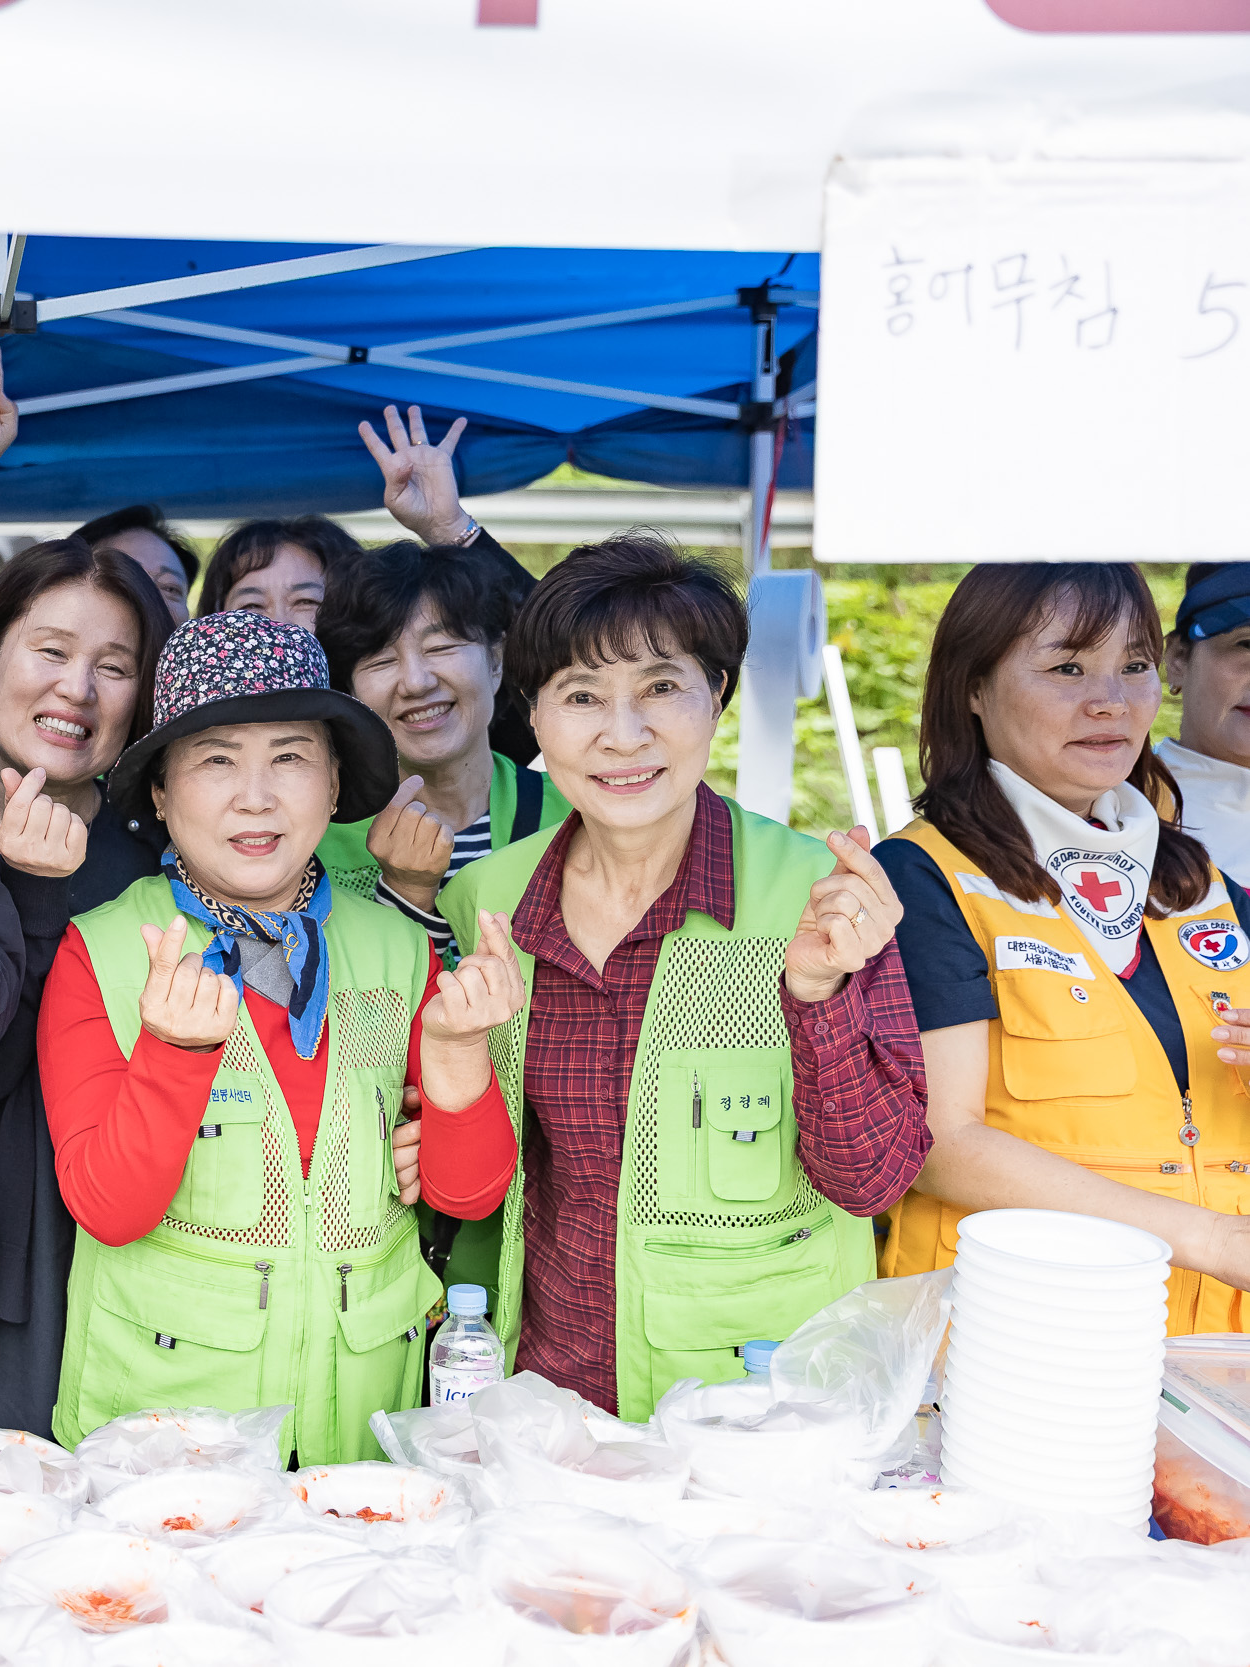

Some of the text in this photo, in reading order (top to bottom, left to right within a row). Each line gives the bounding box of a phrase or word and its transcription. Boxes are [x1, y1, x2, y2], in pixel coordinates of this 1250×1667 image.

[882, 245, 1247, 360] 홍어무침 5
[209, 1088, 253, 1103] 원봉사센터
[446, 1388, 475, 1401] Ici
